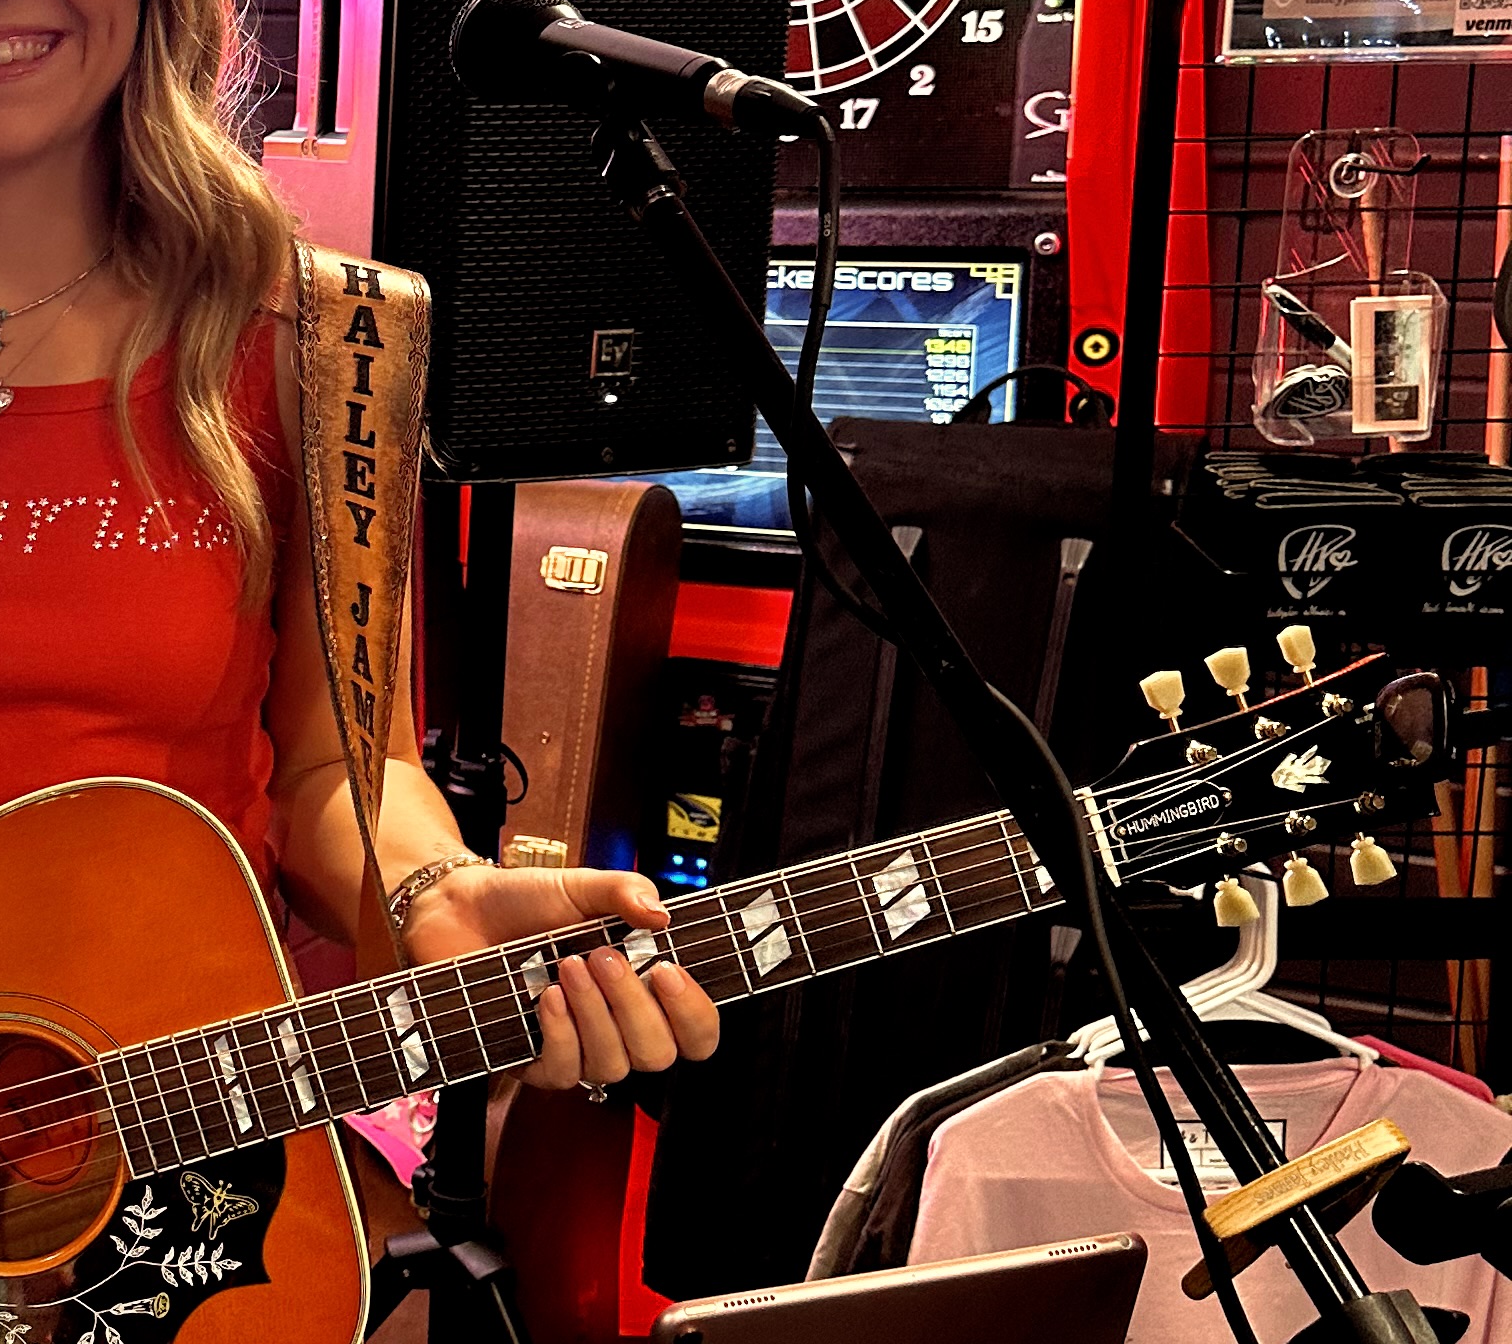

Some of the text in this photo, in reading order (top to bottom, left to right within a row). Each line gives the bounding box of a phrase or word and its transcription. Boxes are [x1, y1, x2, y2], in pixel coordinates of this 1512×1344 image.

[960, 8, 1005, 43] 15
[908, 64, 936, 97] 2
[839, 97, 882, 130] 17
[834, 267, 955, 292] Scores
[339, 261, 383, 551] HAILEY
[1125, 794, 1220, 836] HUMMINGBIRD
